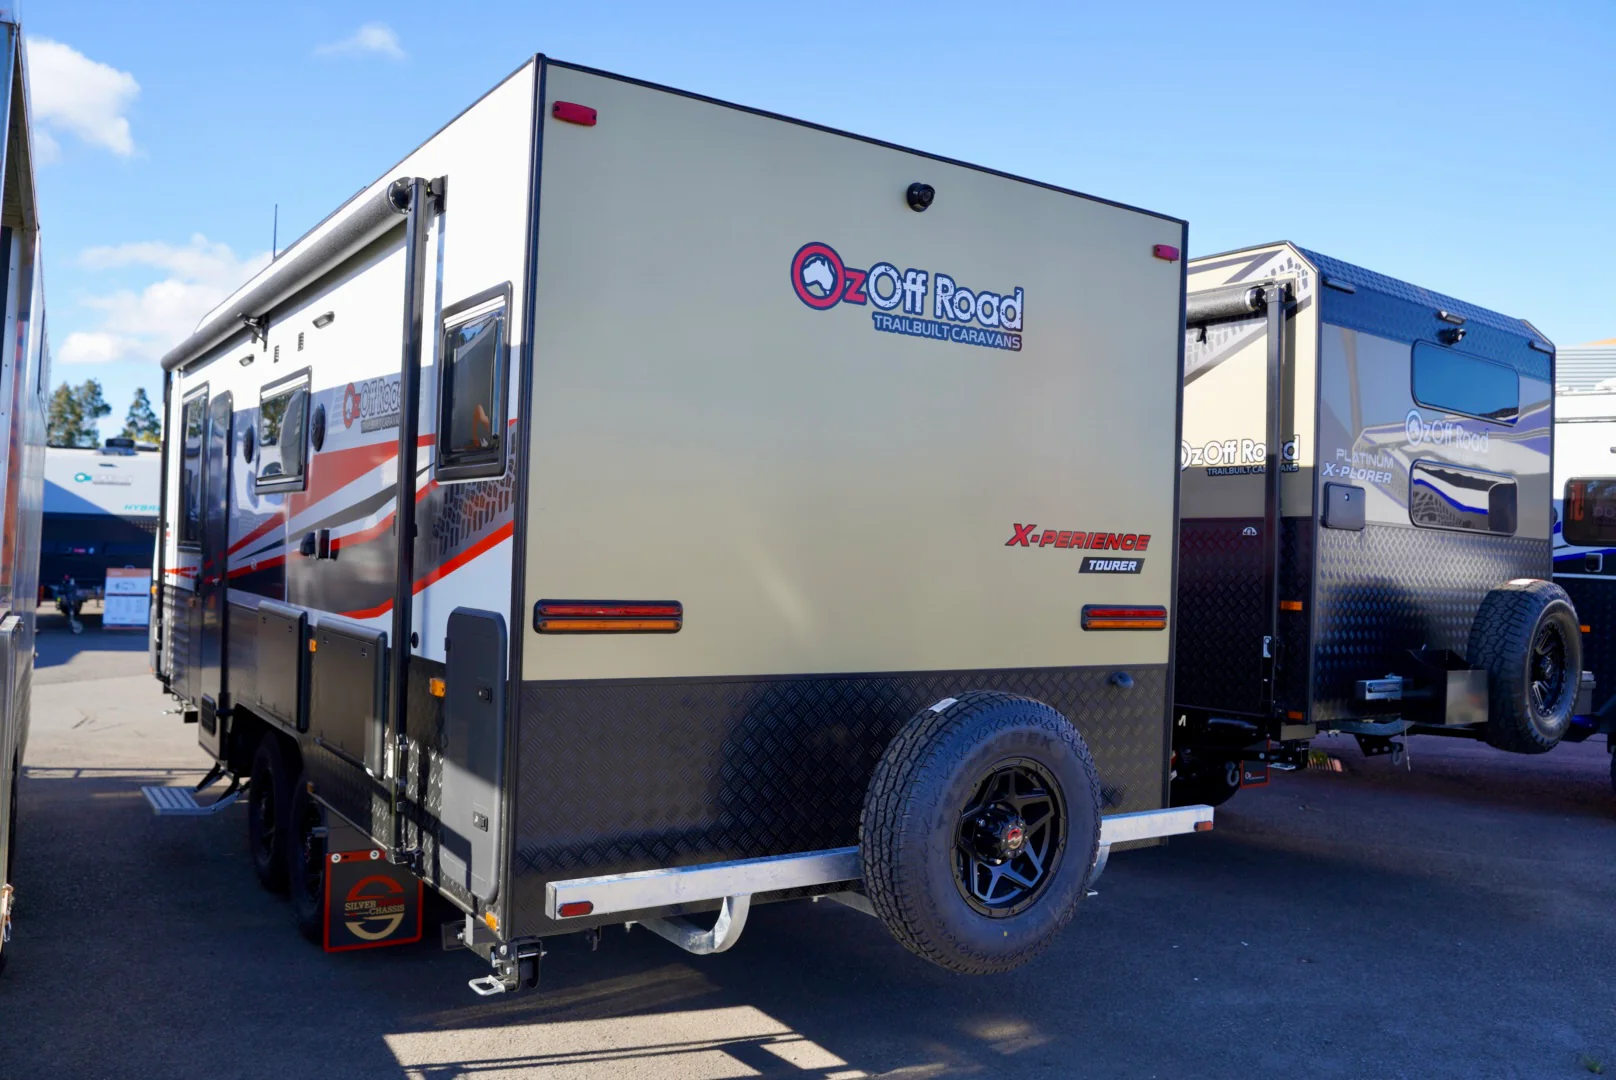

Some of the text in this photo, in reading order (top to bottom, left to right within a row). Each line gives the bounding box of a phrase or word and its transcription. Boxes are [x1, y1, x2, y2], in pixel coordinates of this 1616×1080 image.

[934, 273, 1024, 331] Road
[873, 313, 1022, 351] TRAILBUILT CARAVANS
[1241, 434, 1300, 463] Rod
[1336, 448, 1394, 469] PLATINUM
[1207, 466, 1251, 476] TRAILBUILT
[1322, 462, 1392, 484] X-PLORER
[1005, 523, 1151, 551] X-PERIENCE
[1088, 559, 1138, 571] TOURER
[344, 900, 377, 911] SILVER
[368, 904, 405, 915] CHASSIS
